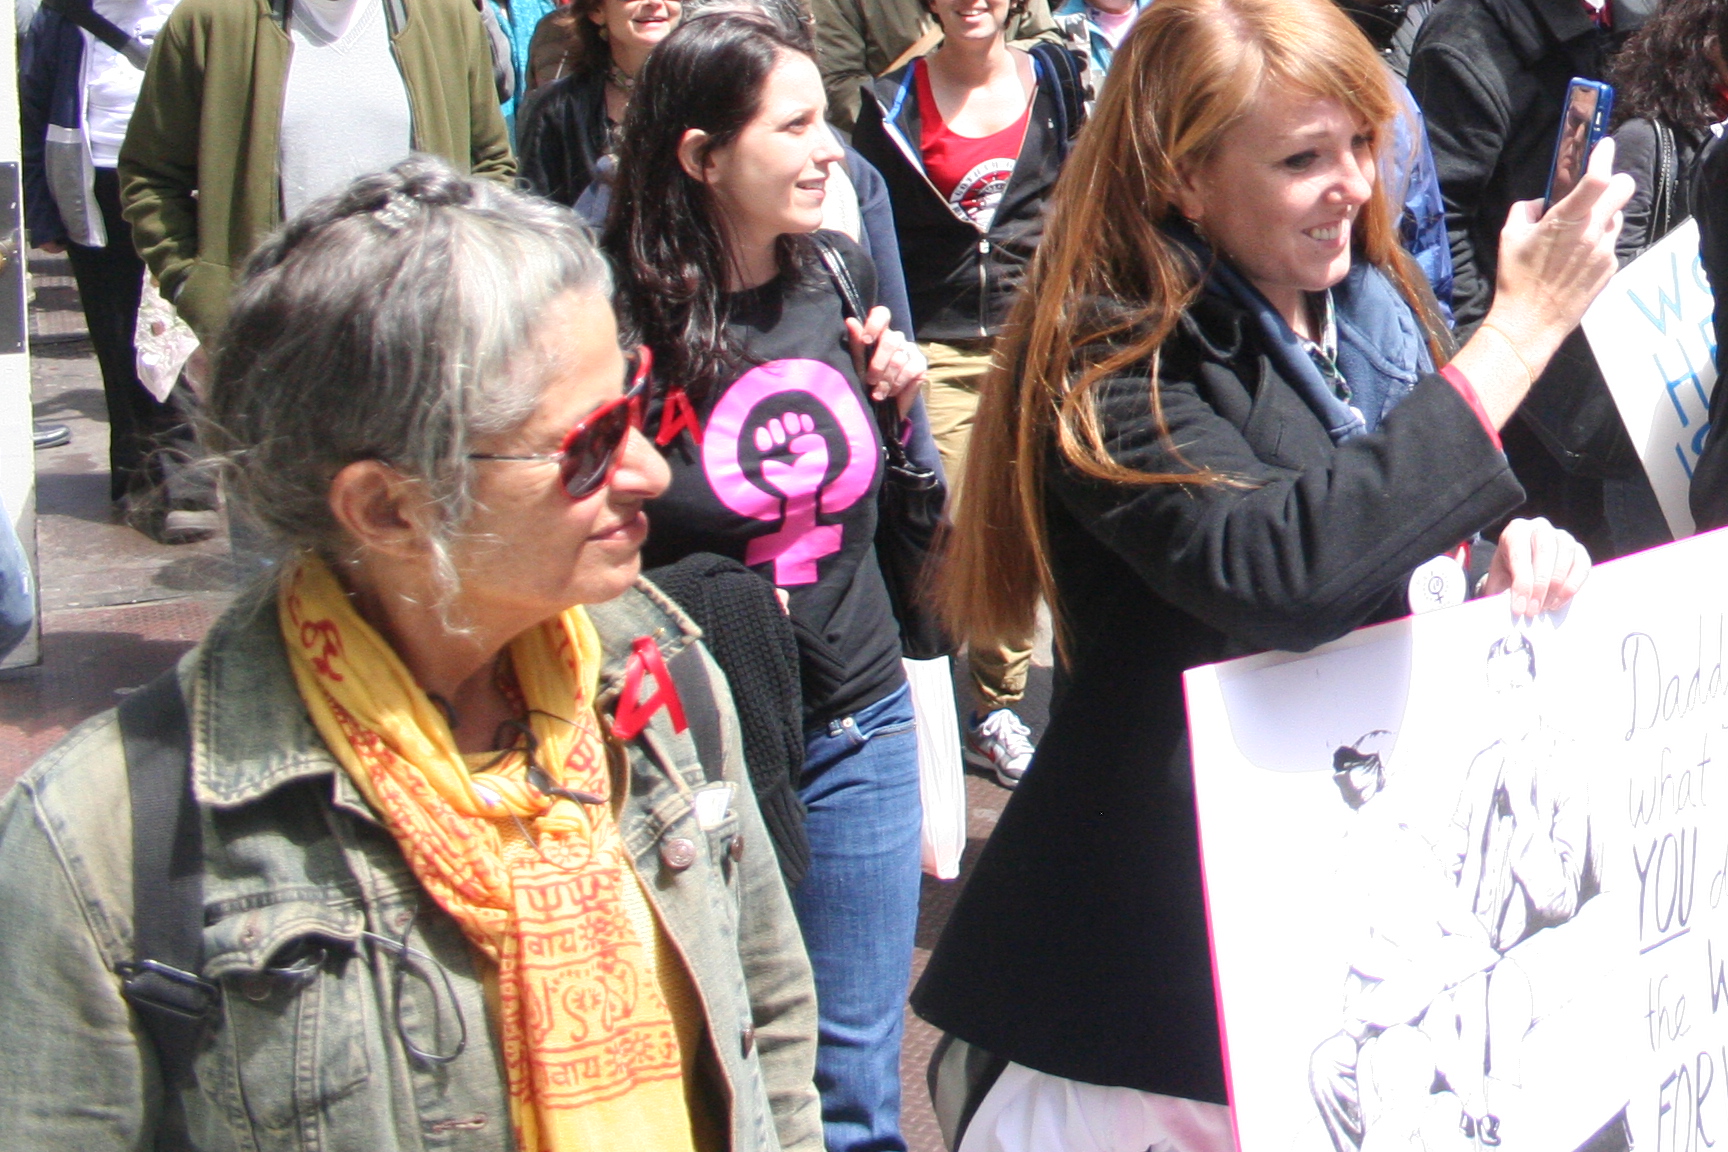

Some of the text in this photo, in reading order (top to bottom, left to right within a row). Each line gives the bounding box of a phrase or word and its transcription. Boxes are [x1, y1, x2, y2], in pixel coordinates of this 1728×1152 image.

[1629, 733, 1711, 829] what
[1632, 826, 1698, 943] YOU
[1643, 973, 1692, 1053] the
